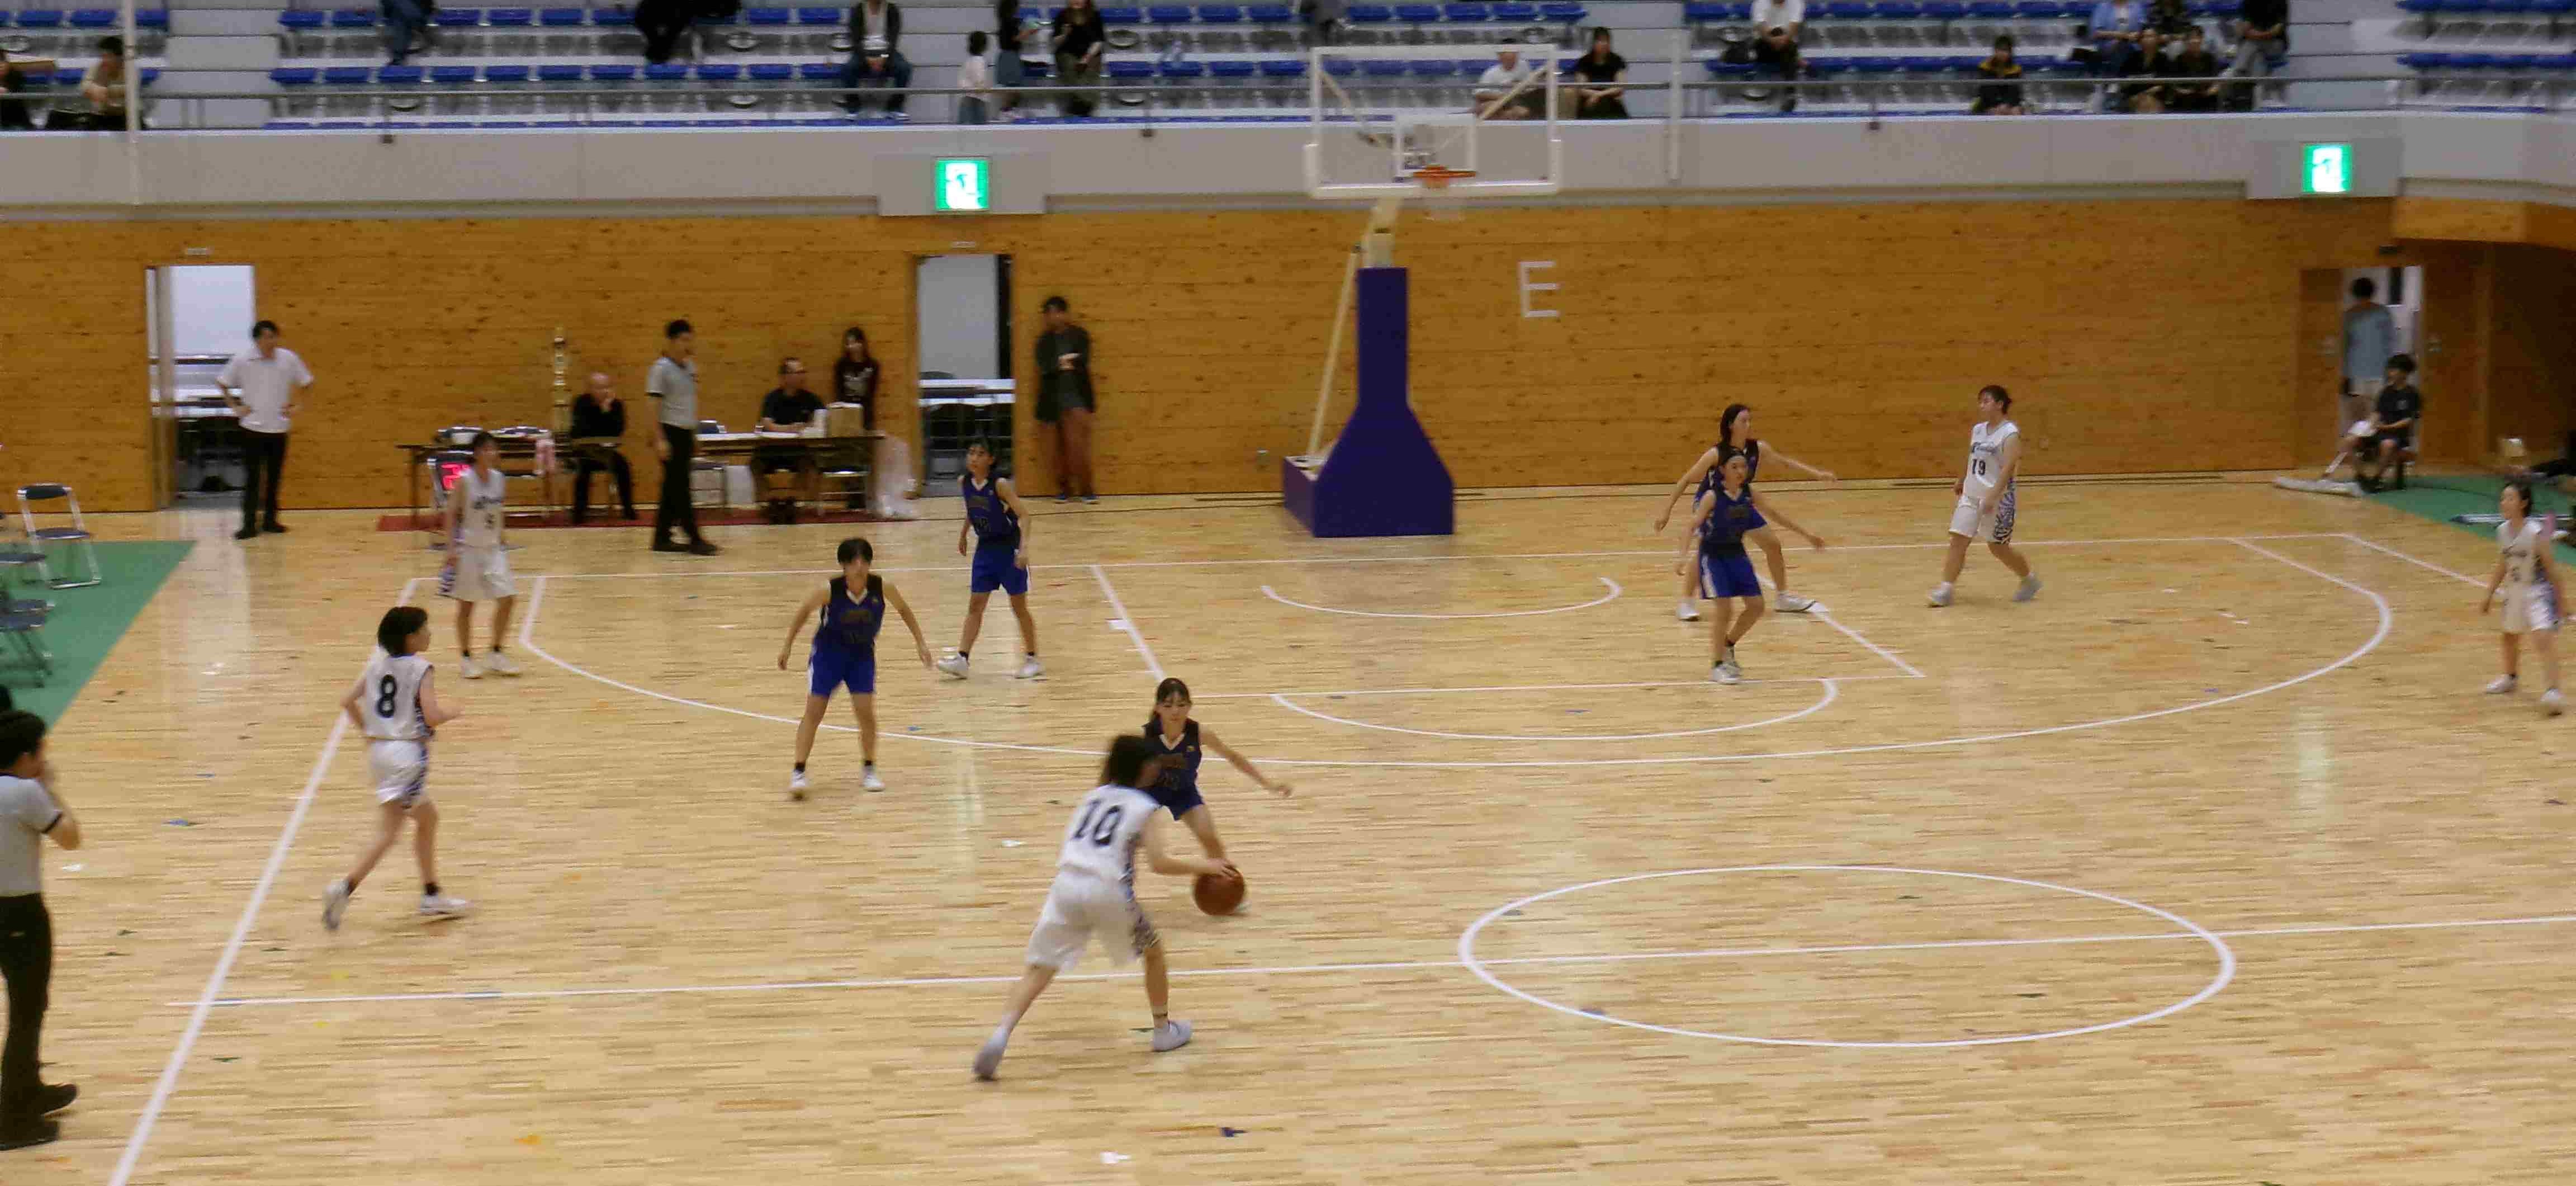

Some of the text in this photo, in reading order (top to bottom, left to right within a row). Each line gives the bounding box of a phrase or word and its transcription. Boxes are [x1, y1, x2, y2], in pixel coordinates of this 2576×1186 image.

[1518, 261, 1562, 318] E
[1972, 459, 1986, 476] 19
[377, 674, 397, 718] 8
[1072, 798, 1123, 846] 10
